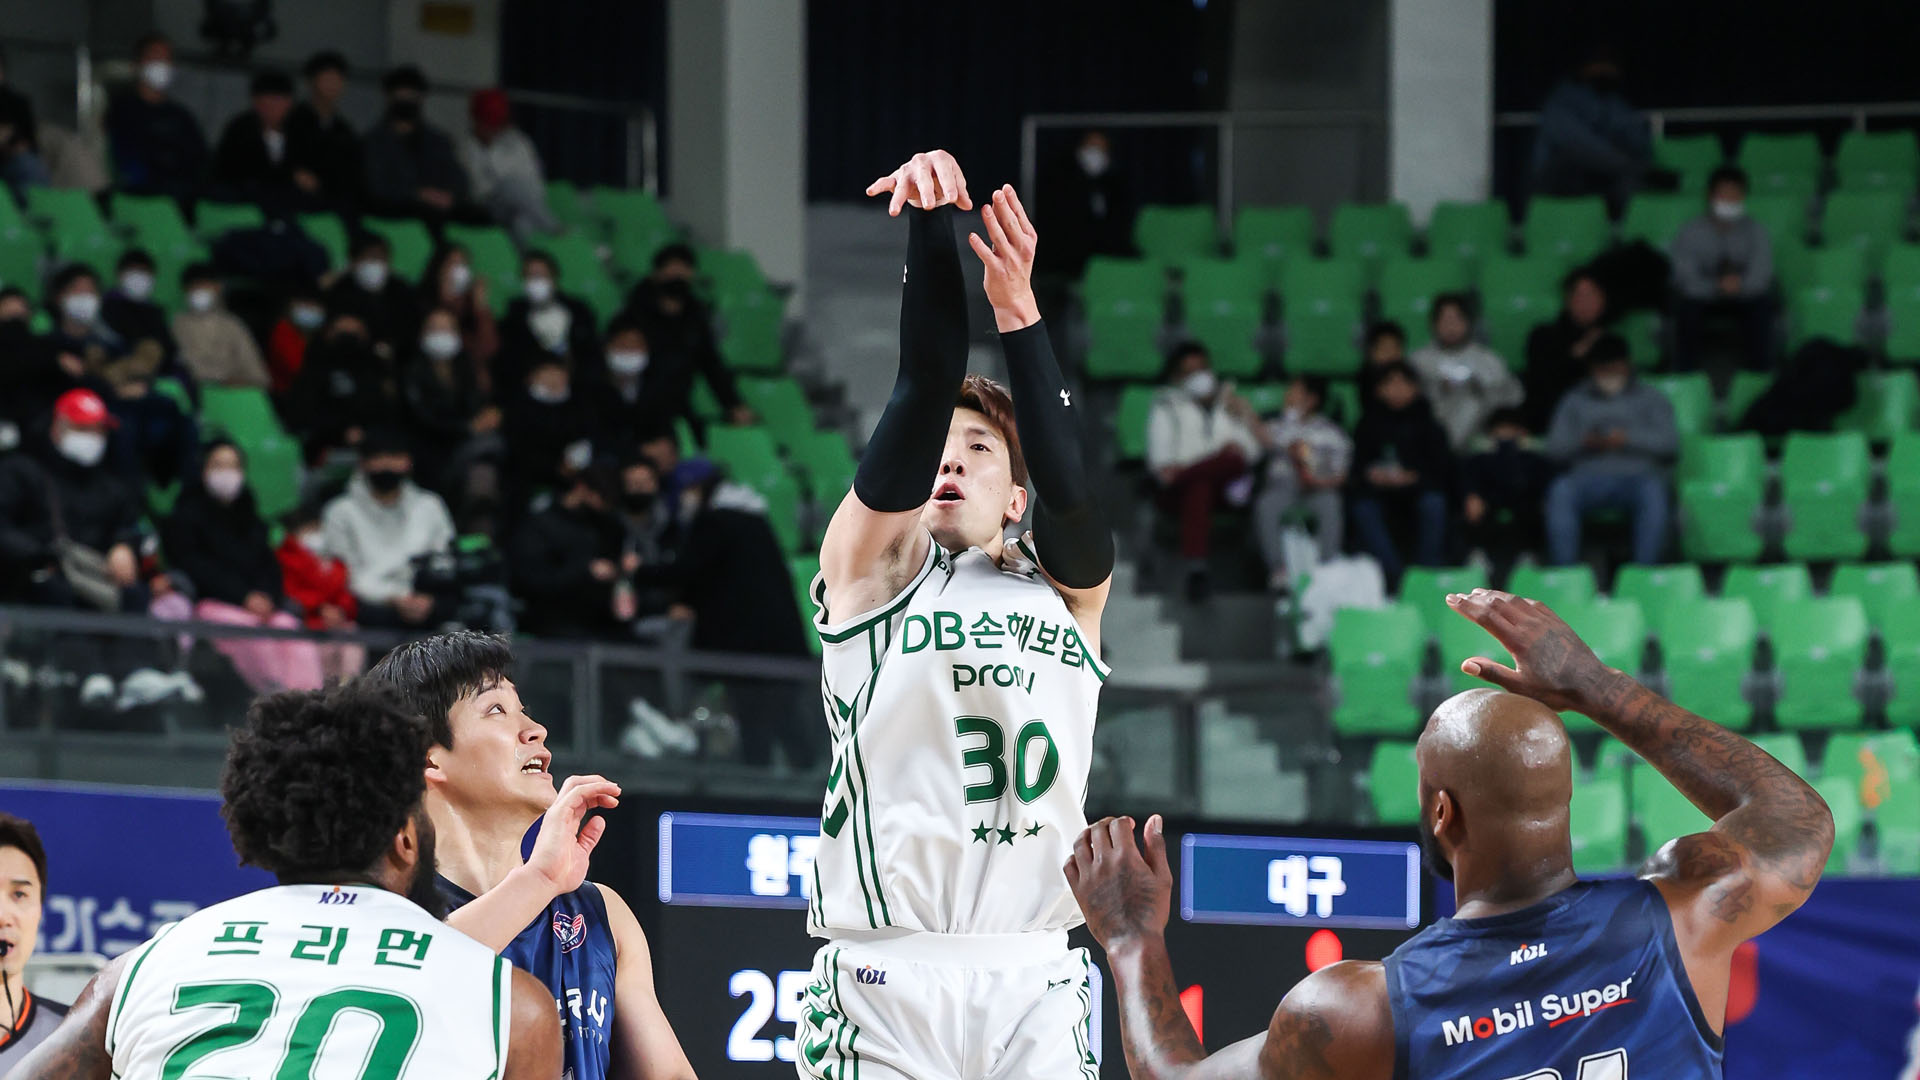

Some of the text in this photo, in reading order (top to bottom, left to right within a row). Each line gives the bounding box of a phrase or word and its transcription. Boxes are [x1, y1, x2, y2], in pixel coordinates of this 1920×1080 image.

[953, 714, 1060, 806] 30
[1268, 855, 1346, 918] 대구
[856, 966, 887, 985] KBL
[1510, 943, 1548, 966] KBL
[156, 979, 424, 1080] 20
[1441, 977, 1633, 1046] Mobil Super
